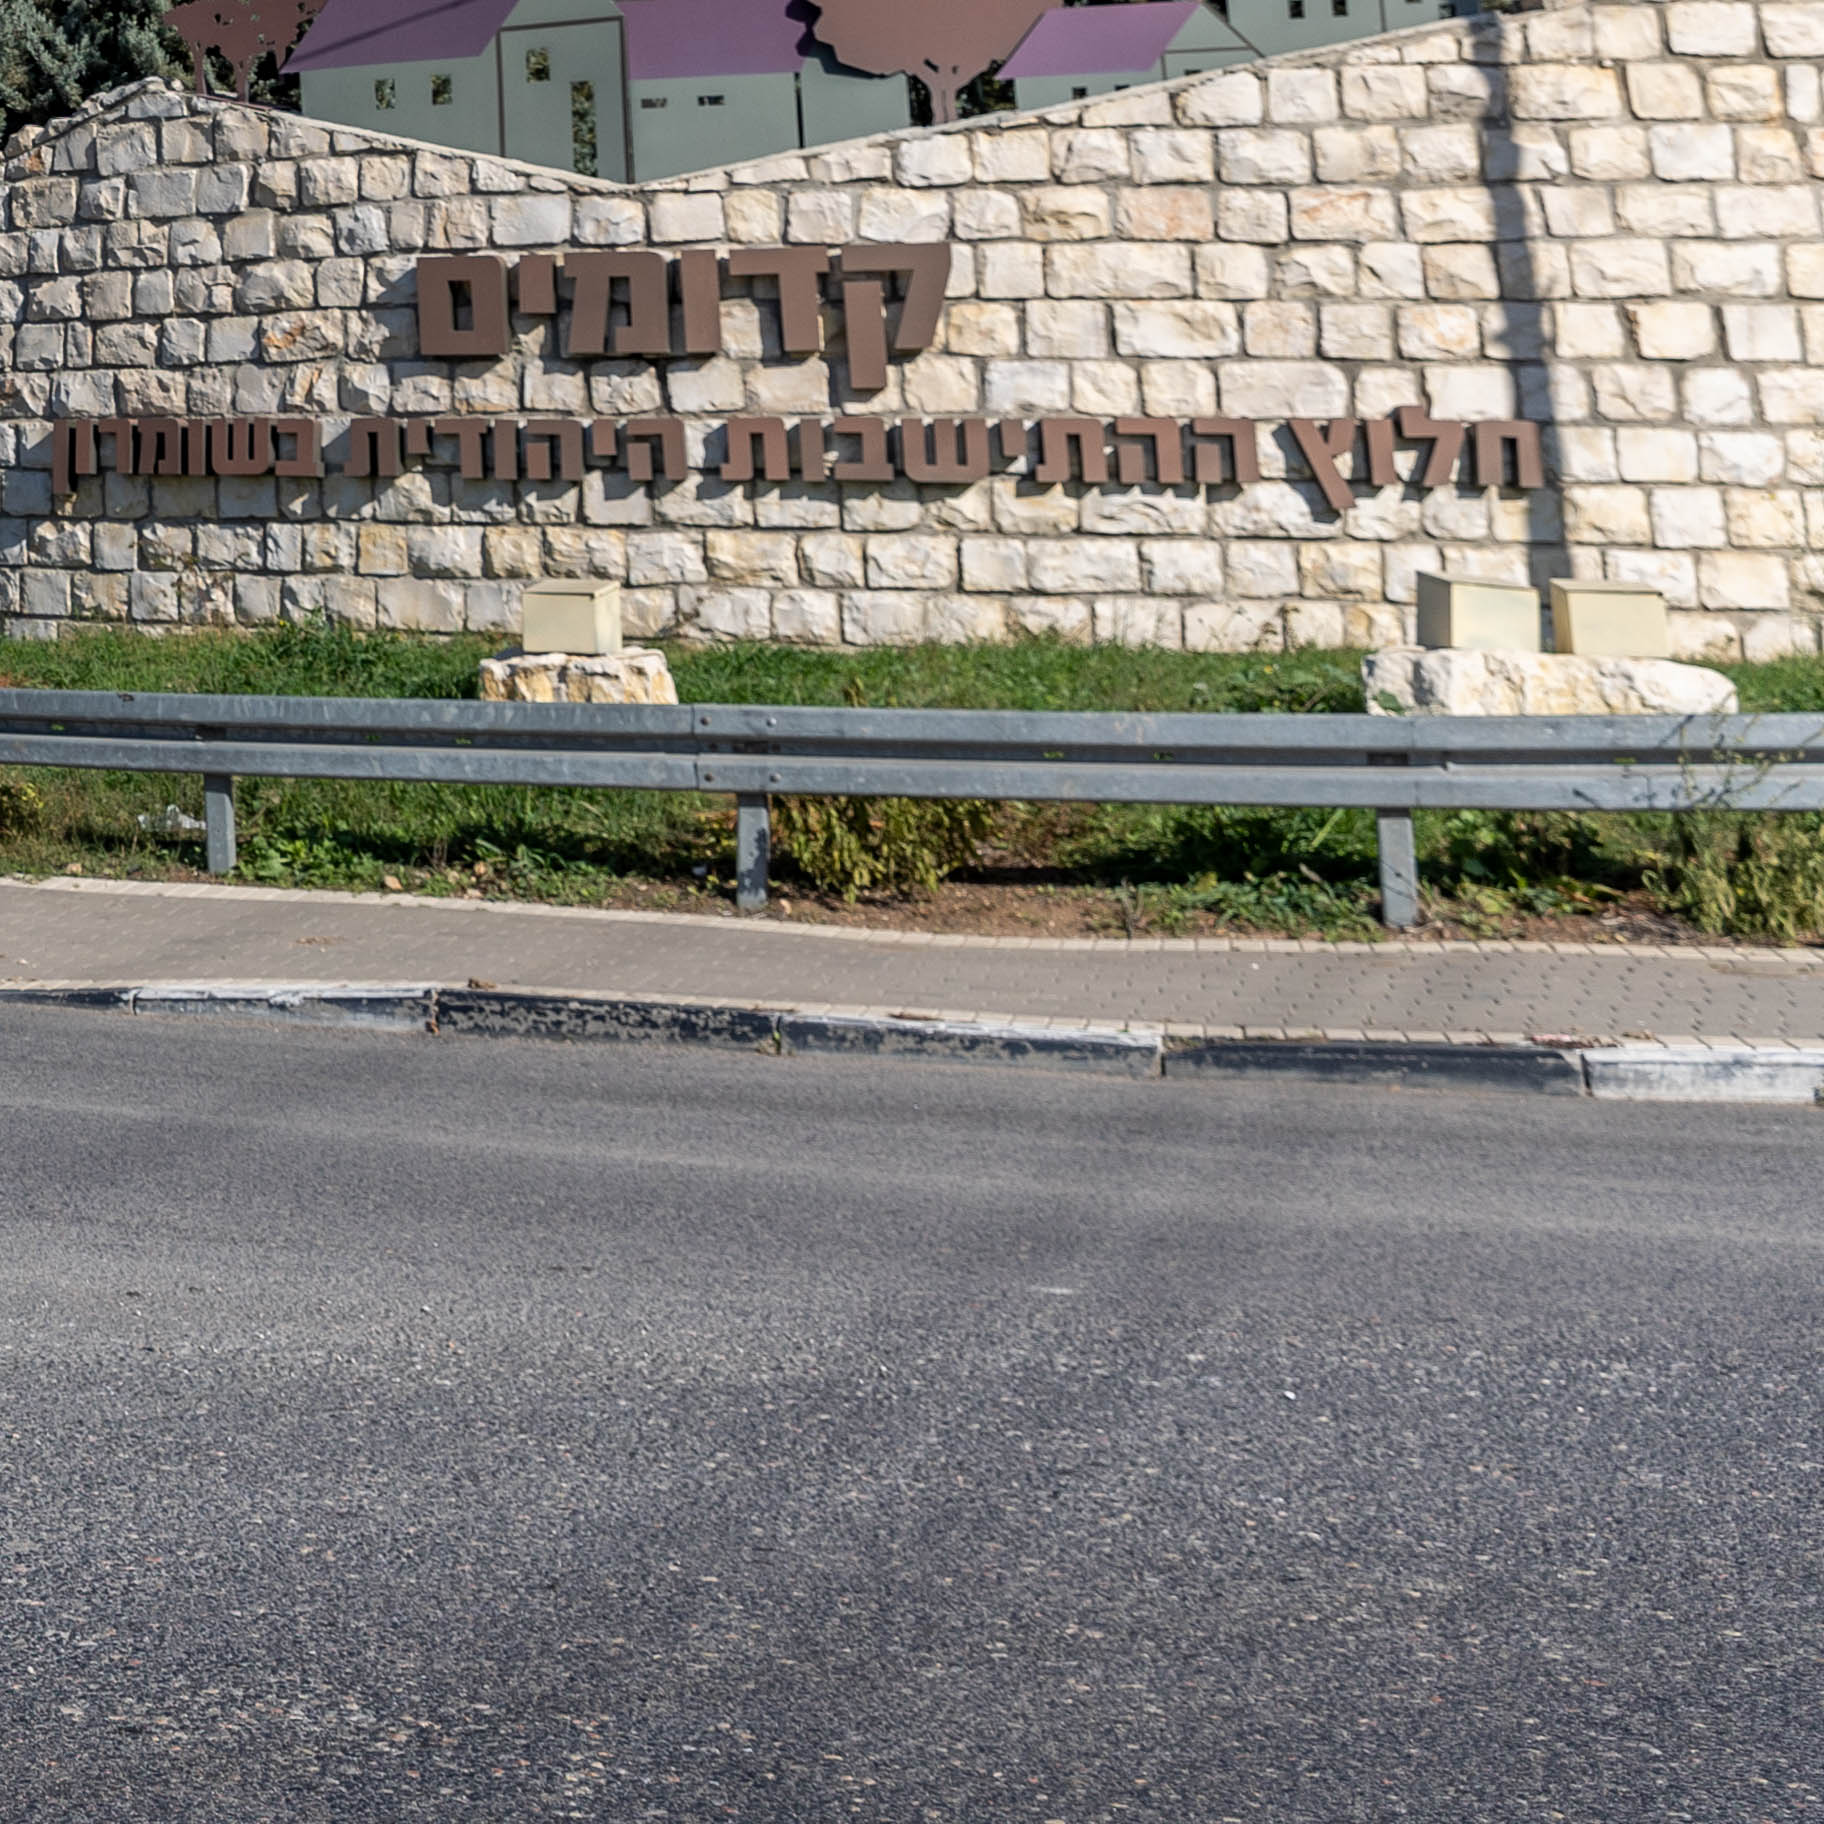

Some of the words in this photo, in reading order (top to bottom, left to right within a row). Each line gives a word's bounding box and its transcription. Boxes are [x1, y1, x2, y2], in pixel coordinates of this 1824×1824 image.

[416, 242, 952, 389] קדומים
[53, 417, 325, 496] בשומרון
[343, 417, 688, 482] היהודית
[720, 416, 1259, 483] ההתישבות
[1288, 405, 1542, 510] חלוץ
